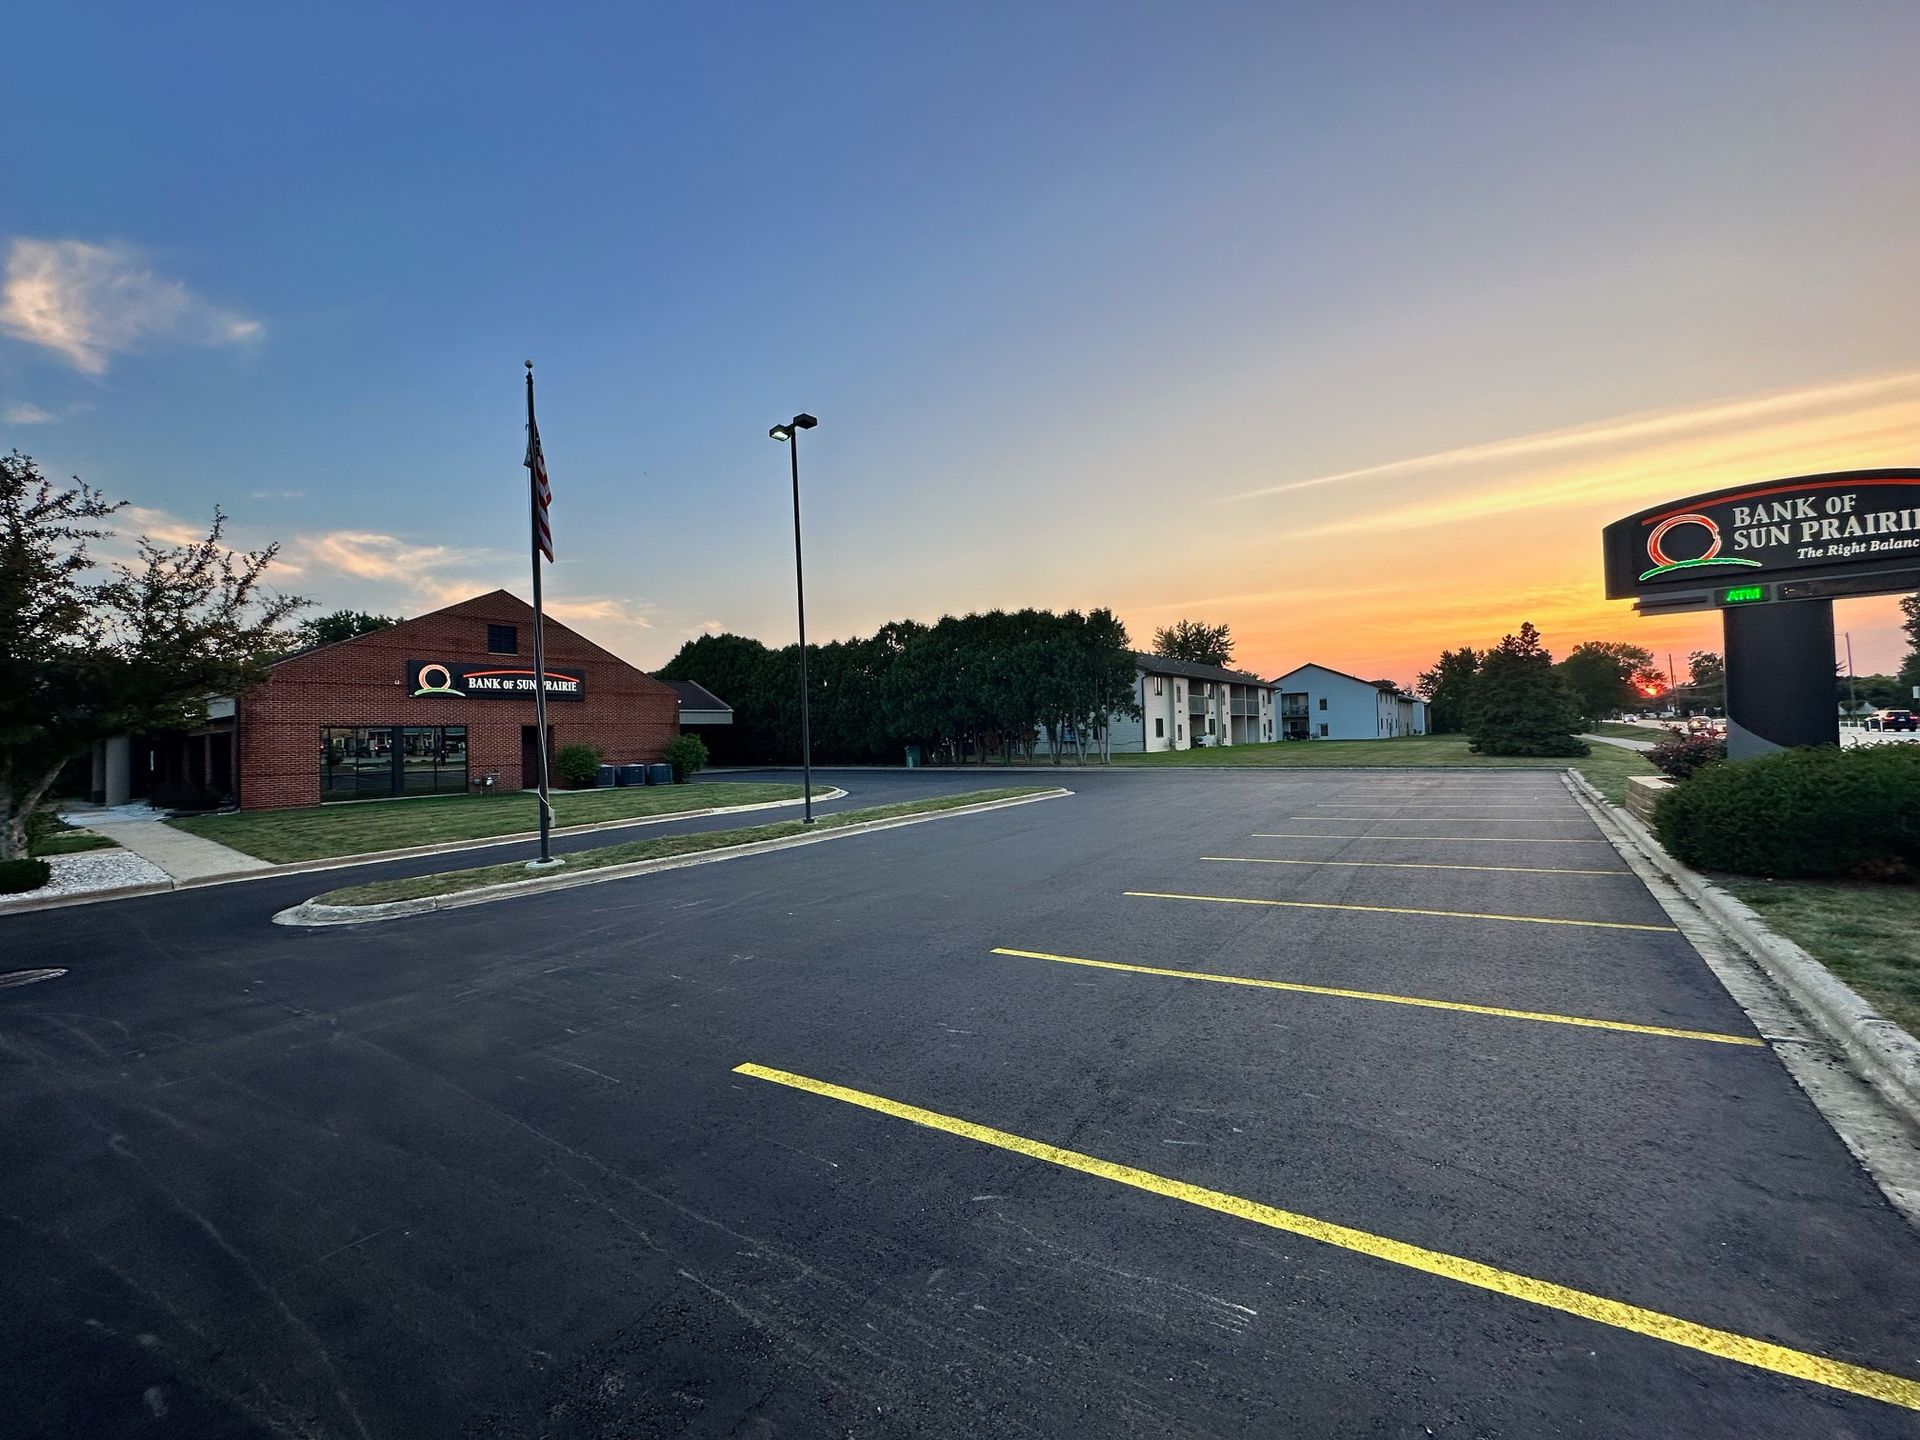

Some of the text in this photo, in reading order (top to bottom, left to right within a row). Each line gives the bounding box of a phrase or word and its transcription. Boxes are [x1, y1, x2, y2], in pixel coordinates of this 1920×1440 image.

[1732, 494, 1856, 527] BANK OF
[1733, 524, 1791, 551] SUN
[1797, 538, 1920, 560] The Right Balanc
[1727, 588, 1761, 601] ATM
[468, 678, 501, 689] BANK
[503, 679, 515, 690] OF
[516, 679, 537, 690] SUN
